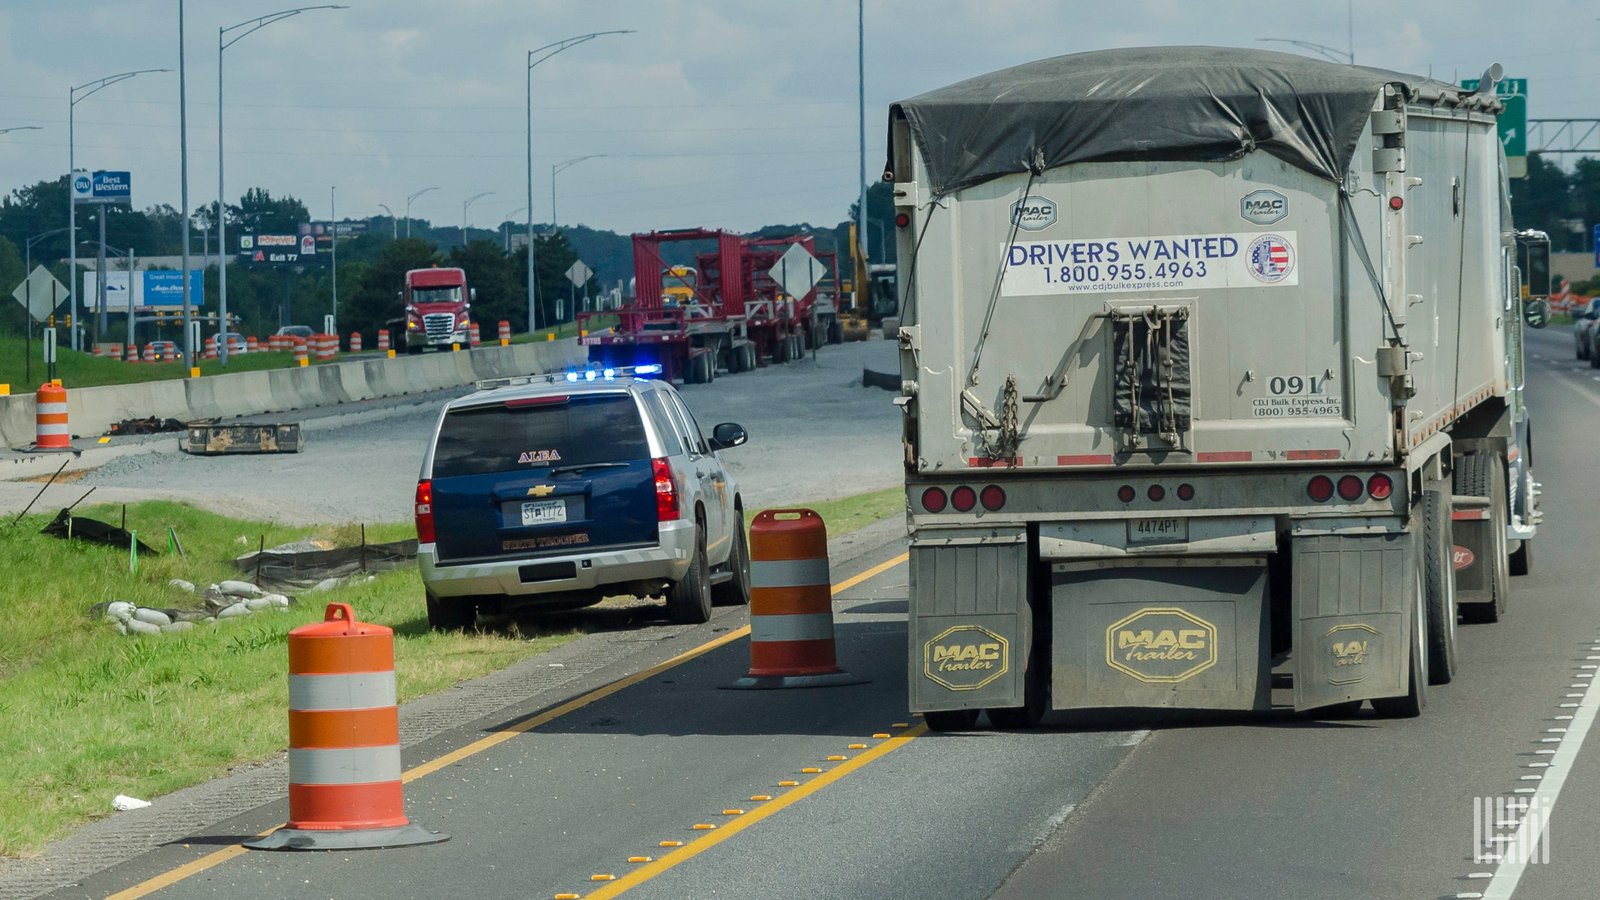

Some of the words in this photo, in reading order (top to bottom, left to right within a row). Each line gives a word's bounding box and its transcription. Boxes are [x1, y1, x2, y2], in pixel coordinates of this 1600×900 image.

[76, 181, 90, 189] BW
[1015, 206, 1052, 215] MAC
[1246, 200, 1283, 209] MAC
[1009, 242, 1120, 266] DRIVERS
[1128, 237, 1239, 261] WANTED
[1044, 261, 1207, 283] 1.800.955.4963
[1068, 280, 1184, 291] www.cdjbulkexpress.com
[1270, 376, 1319, 395] 091
[1252, 399, 1269, 407] CDJ
[1271, 398, 1290, 406] Bulk
[1254, 407, 1284, 416] (800)
[1287, 406, 1341, 416] 955-4963
[518, 450, 561, 463] ALEA
[1138, 519, 1178, 533] 4474PT
[1118, 630, 1206, 649] MAC
[934, 644, 1000, 662] MAC
[1122, 642, 1197, 661] Trailer
[937, 656, 993, 672] Trailer
